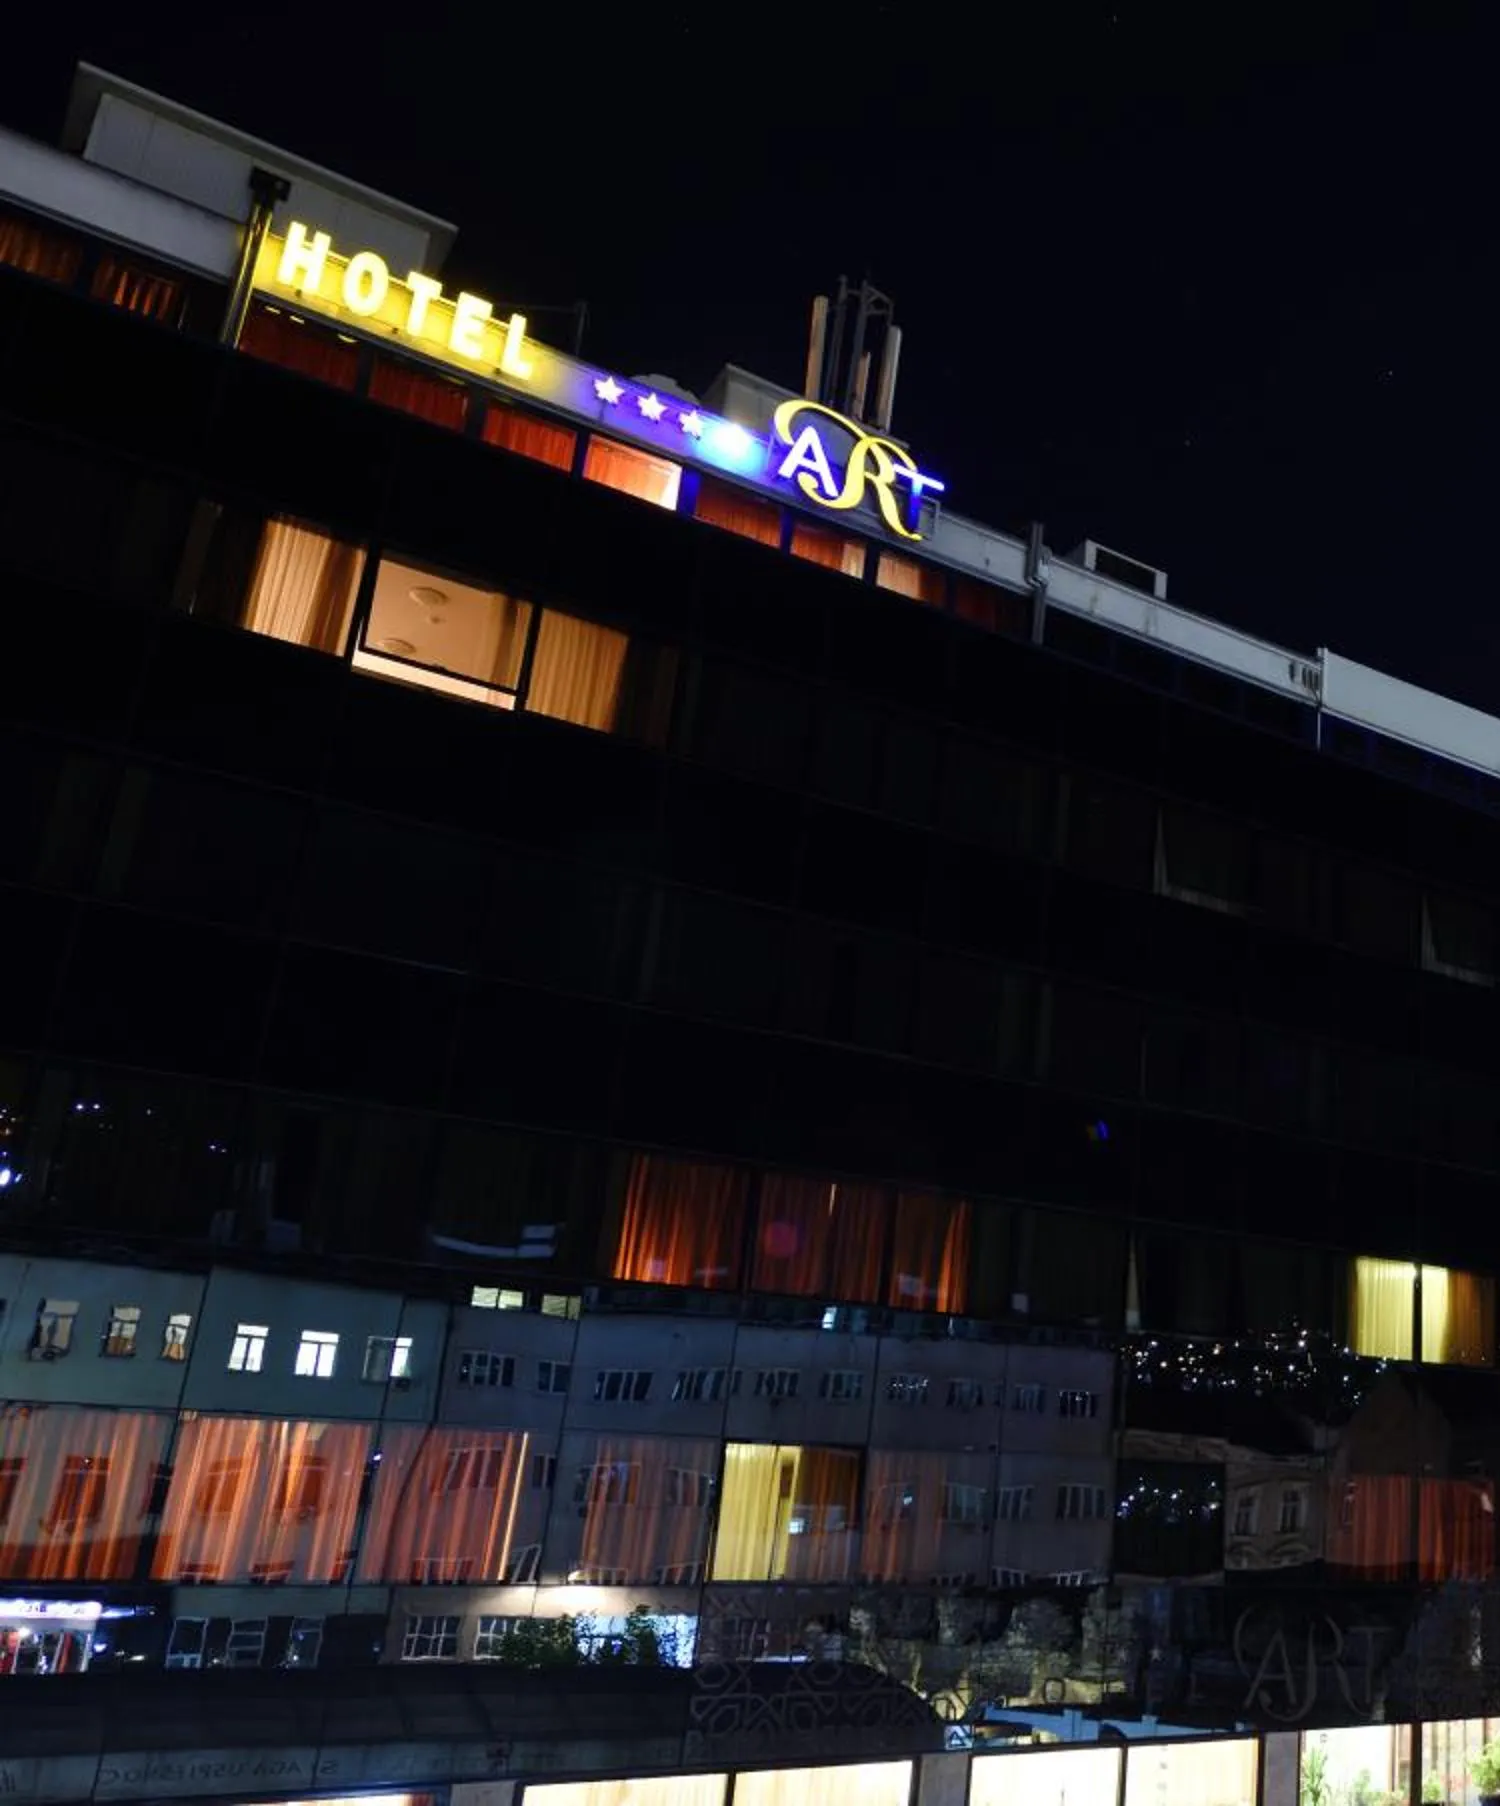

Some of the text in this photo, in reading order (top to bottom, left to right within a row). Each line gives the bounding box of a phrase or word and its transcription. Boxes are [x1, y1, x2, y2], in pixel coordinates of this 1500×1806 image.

[277, 220, 946, 541] HOTEL ART
[1232, 1606, 1395, 1722] ART
